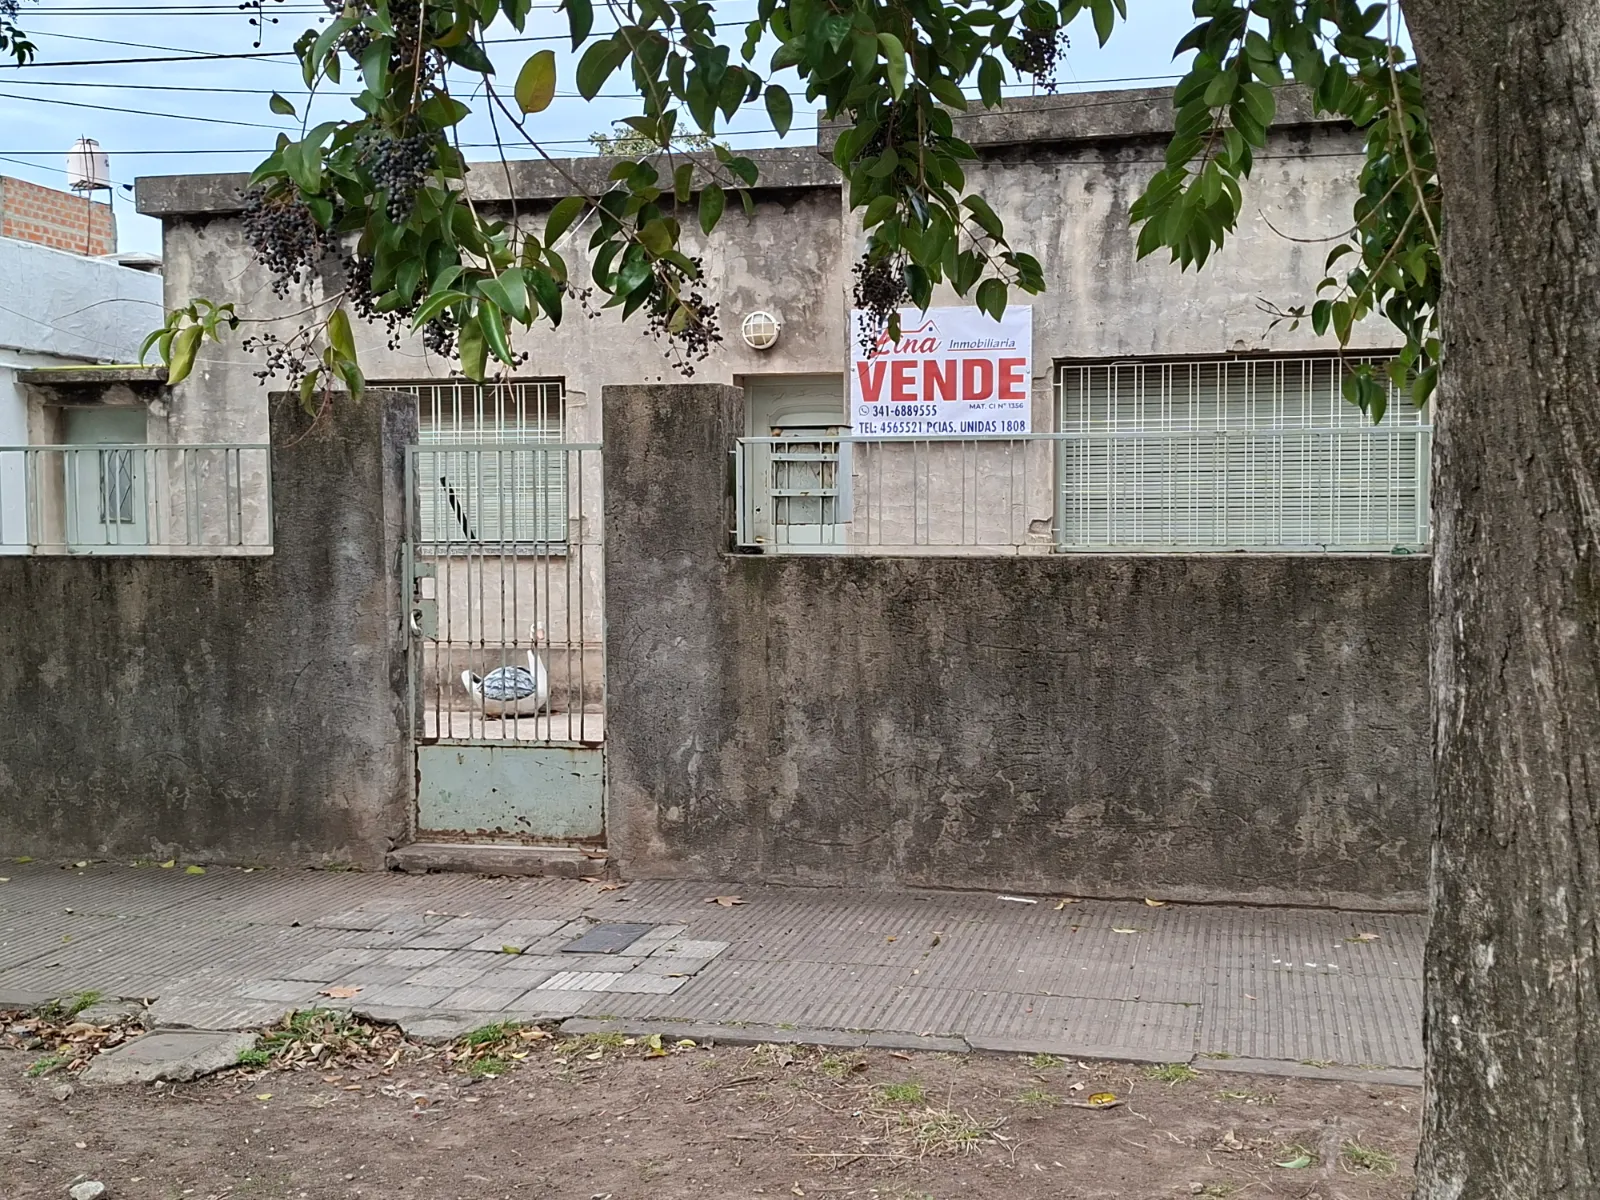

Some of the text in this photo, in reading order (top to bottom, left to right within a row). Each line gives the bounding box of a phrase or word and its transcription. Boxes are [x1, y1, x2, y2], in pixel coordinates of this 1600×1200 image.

[949, 337, 1016, 349] Inmobiliaria
[856, 357, 1026, 402] VENDE
[872, 404, 937, 417] 341-6889555
[859, 420, 1026, 434] TEL: 4565521 PCIAS. UNIDAS 1808
